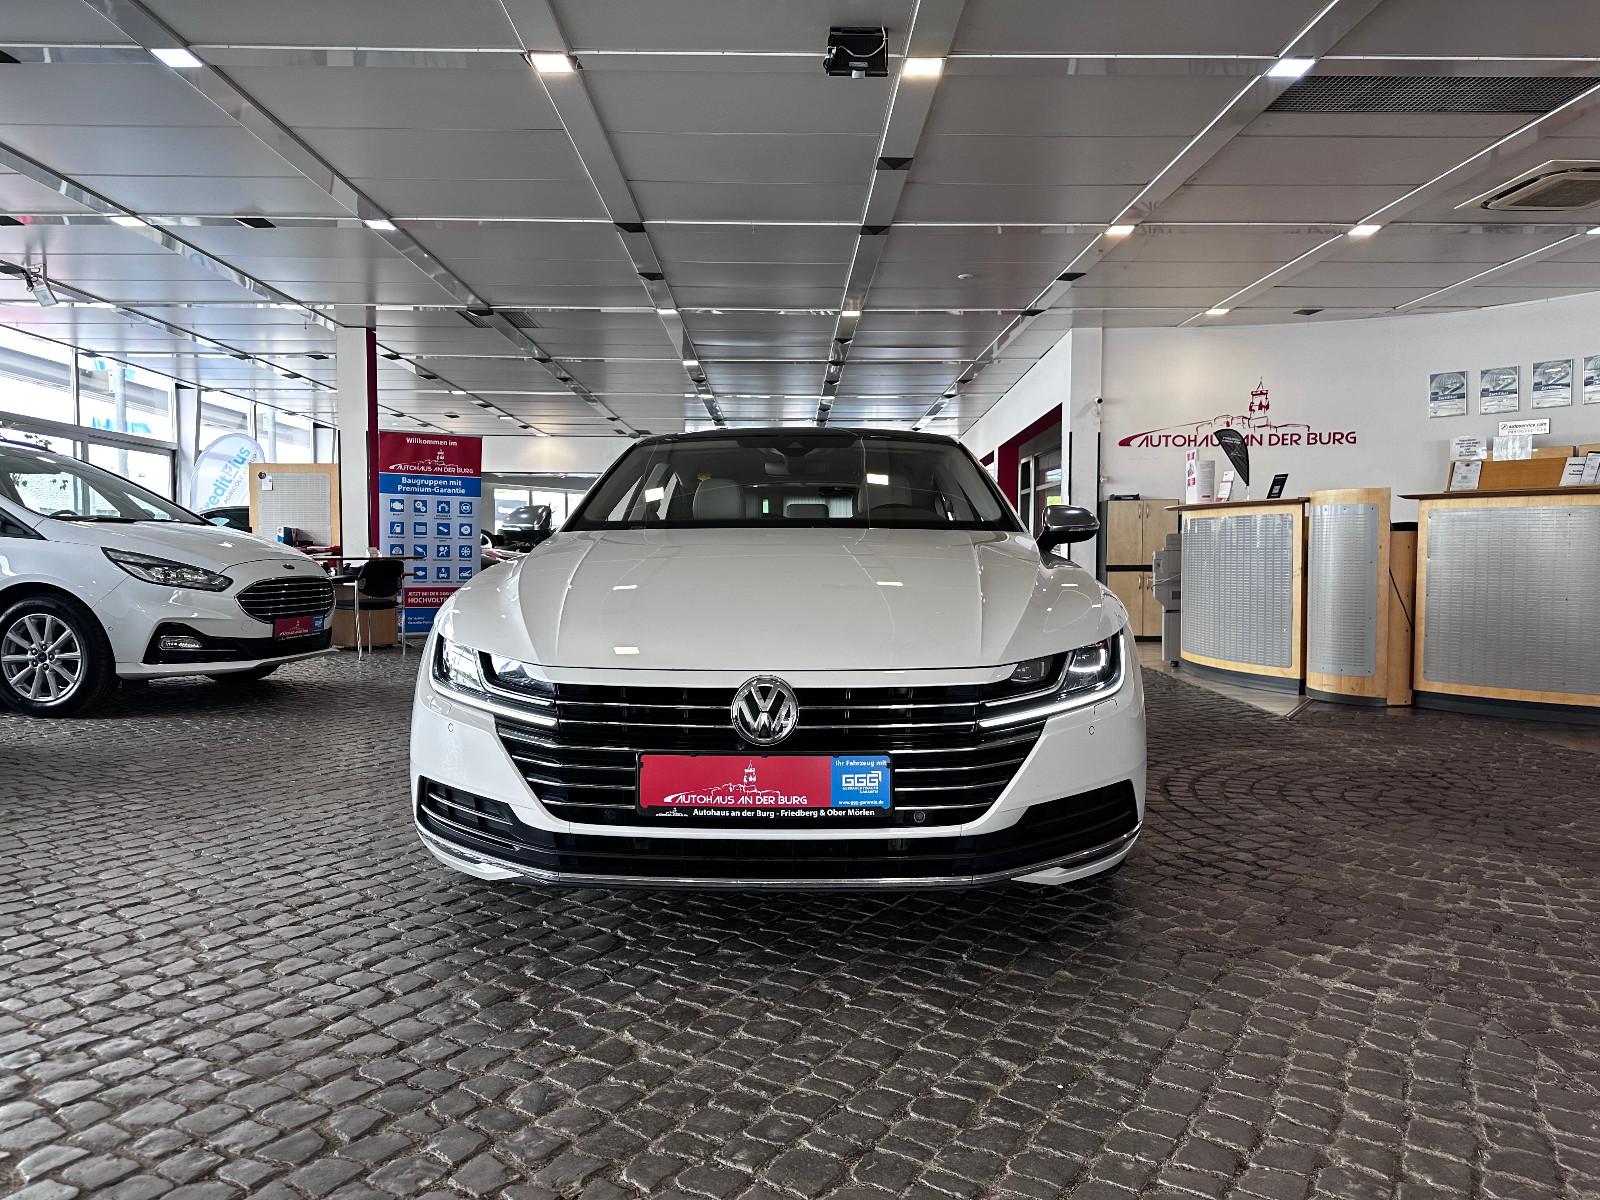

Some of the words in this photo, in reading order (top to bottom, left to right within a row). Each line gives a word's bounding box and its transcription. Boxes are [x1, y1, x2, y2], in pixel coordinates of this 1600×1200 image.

[406, 437, 448, 446] Willkommen
[1137, 434, 1221, 448] AUTOHAU
[1268, 433, 1300, 446] DER
[1307, 431, 1357, 445] BURG
[397, 463, 433, 472] AUTOHAUS
[401, 477, 448, 486] Baugruppen
[397, 485, 466, 494] Premium-Garantie
[842, 773, 879, 787] GGG
[675, 795, 734, 804] AUTOHAUS
[736, 796, 753, 804] AN
[755, 796, 775, 805] DER
[778, 796, 808, 805] BURG
[693, 808, 729, 816] Autohaus
[756, 809, 775, 818] Burg
[780, 809, 818, 818] Friedberg
[847, 808, 875, 816] Mörlen
